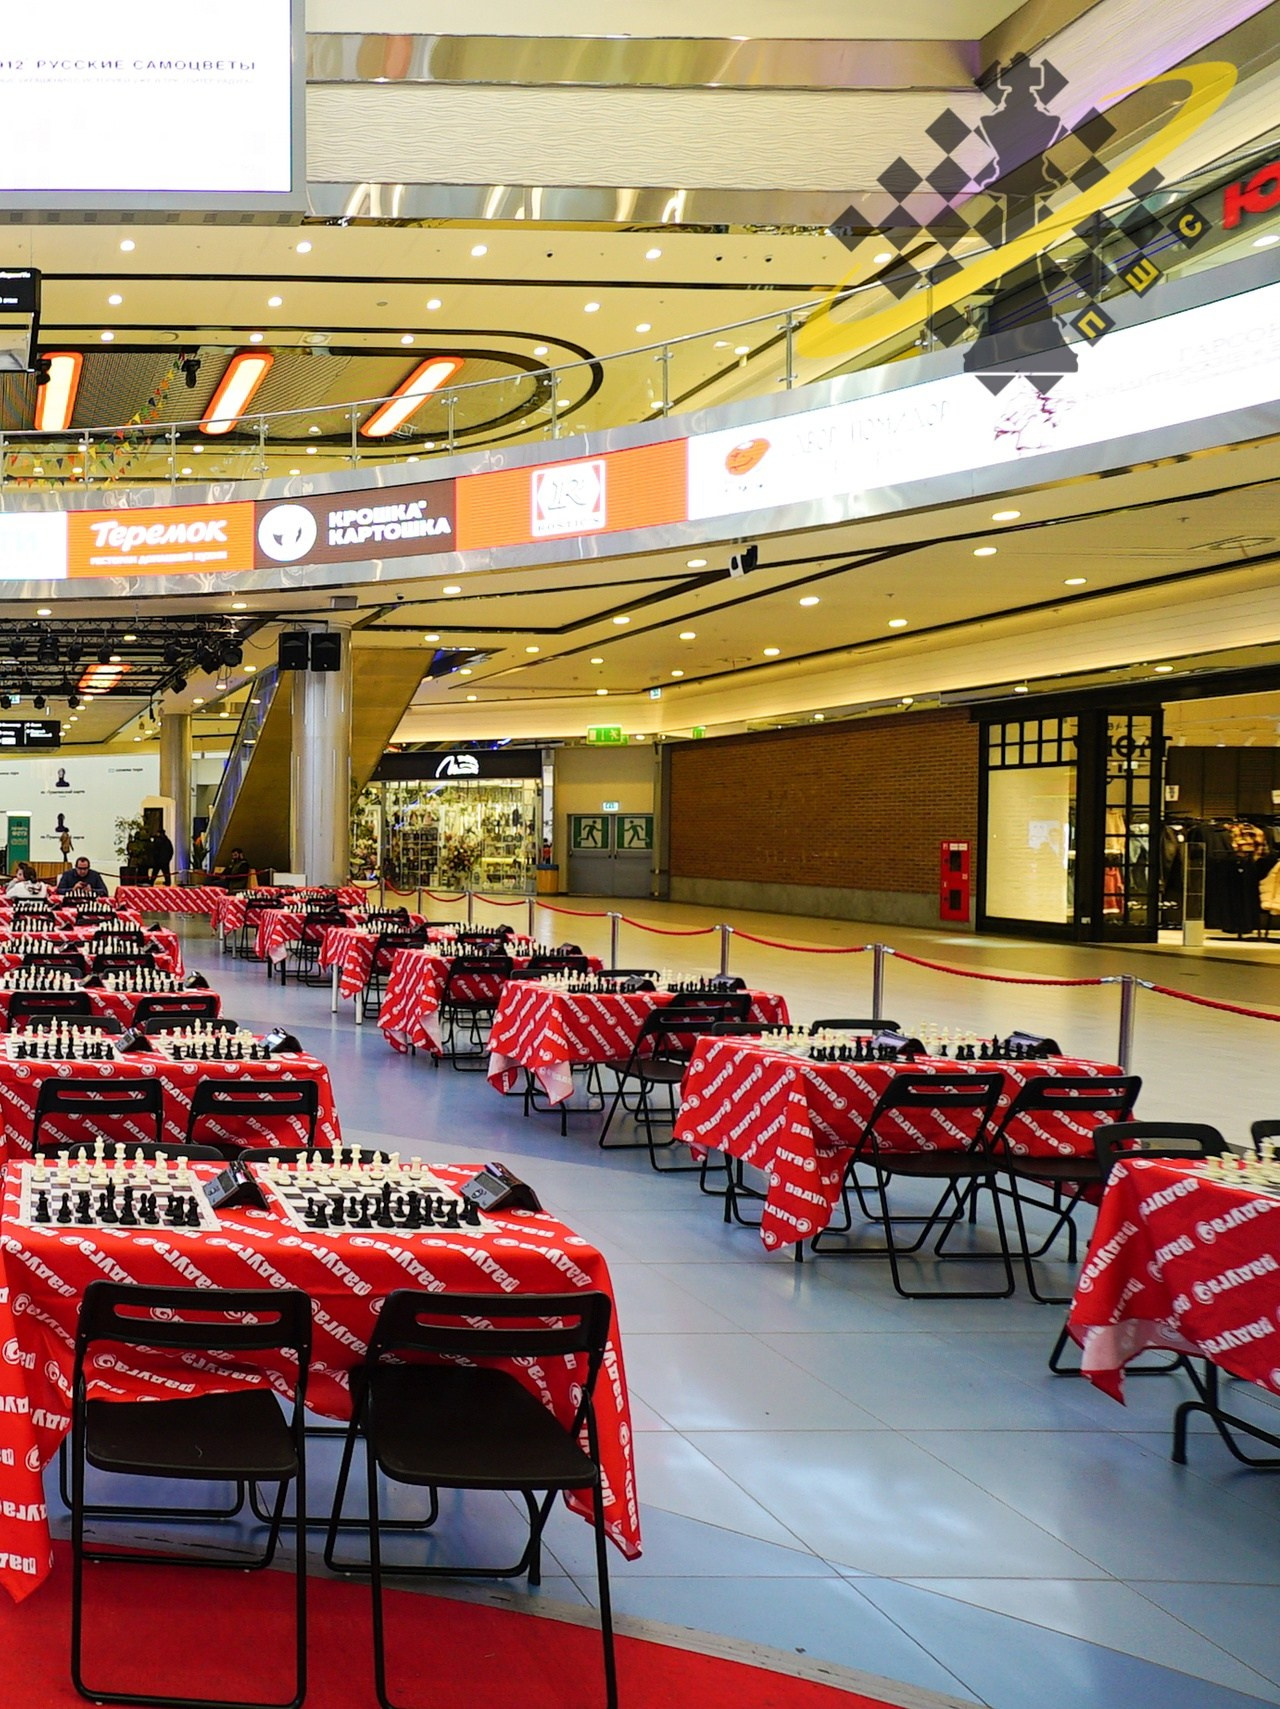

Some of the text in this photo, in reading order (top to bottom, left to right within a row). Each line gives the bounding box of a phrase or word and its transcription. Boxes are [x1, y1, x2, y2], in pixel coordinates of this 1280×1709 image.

[36, 59, 125, 71] РУССКИЕ
[132, 59, 255, 73] САМОЦВЕТЫ
[328, 503, 421, 527] КРОШКА
[328, 517, 452, 547] КАРТОШКА
[90, 519, 228, 552] Теремок
[702, 1069, 729, 1099] радуга
[732, 1072, 759, 1103] радуга
[760, 1073, 790, 1107] радуга
[799, 1065, 839, 1102] радуга
[696, 1105, 727, 1135] радуга
[729, 1109, 758, 1141] радуга
[888, 1108, 927, 1147] радуга
[373, 1241, 447, 1293] радуга
[447, 1243, 520, 1293] радуга
[519, 1242, 592, 1288] радуга
[1084, 1220, 1140, 1282] радуга
[5, 1239, 77, 1299] радуга
[300, 1242, 373, 1297] радуга
[1207, 1253, 1280, 1294] радуга
[114, 1361, 195, 1393] радуга
